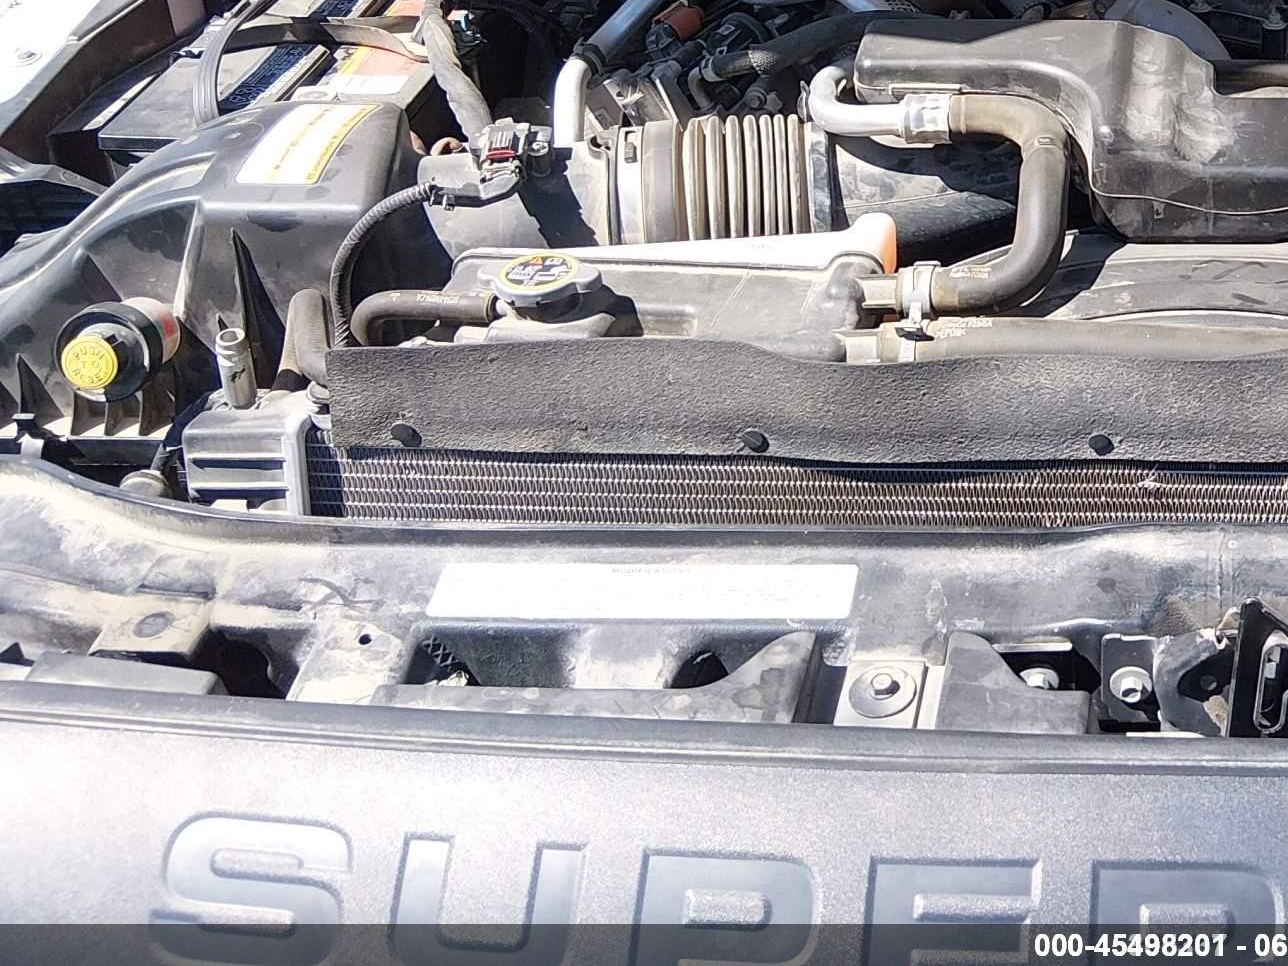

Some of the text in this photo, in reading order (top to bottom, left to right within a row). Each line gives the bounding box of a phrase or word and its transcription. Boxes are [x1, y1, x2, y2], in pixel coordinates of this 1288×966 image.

[72, 345, 105, 361] PUSH
[80, 360, 100, 370] TO
[149, 810, 1285, 966] SUPER
